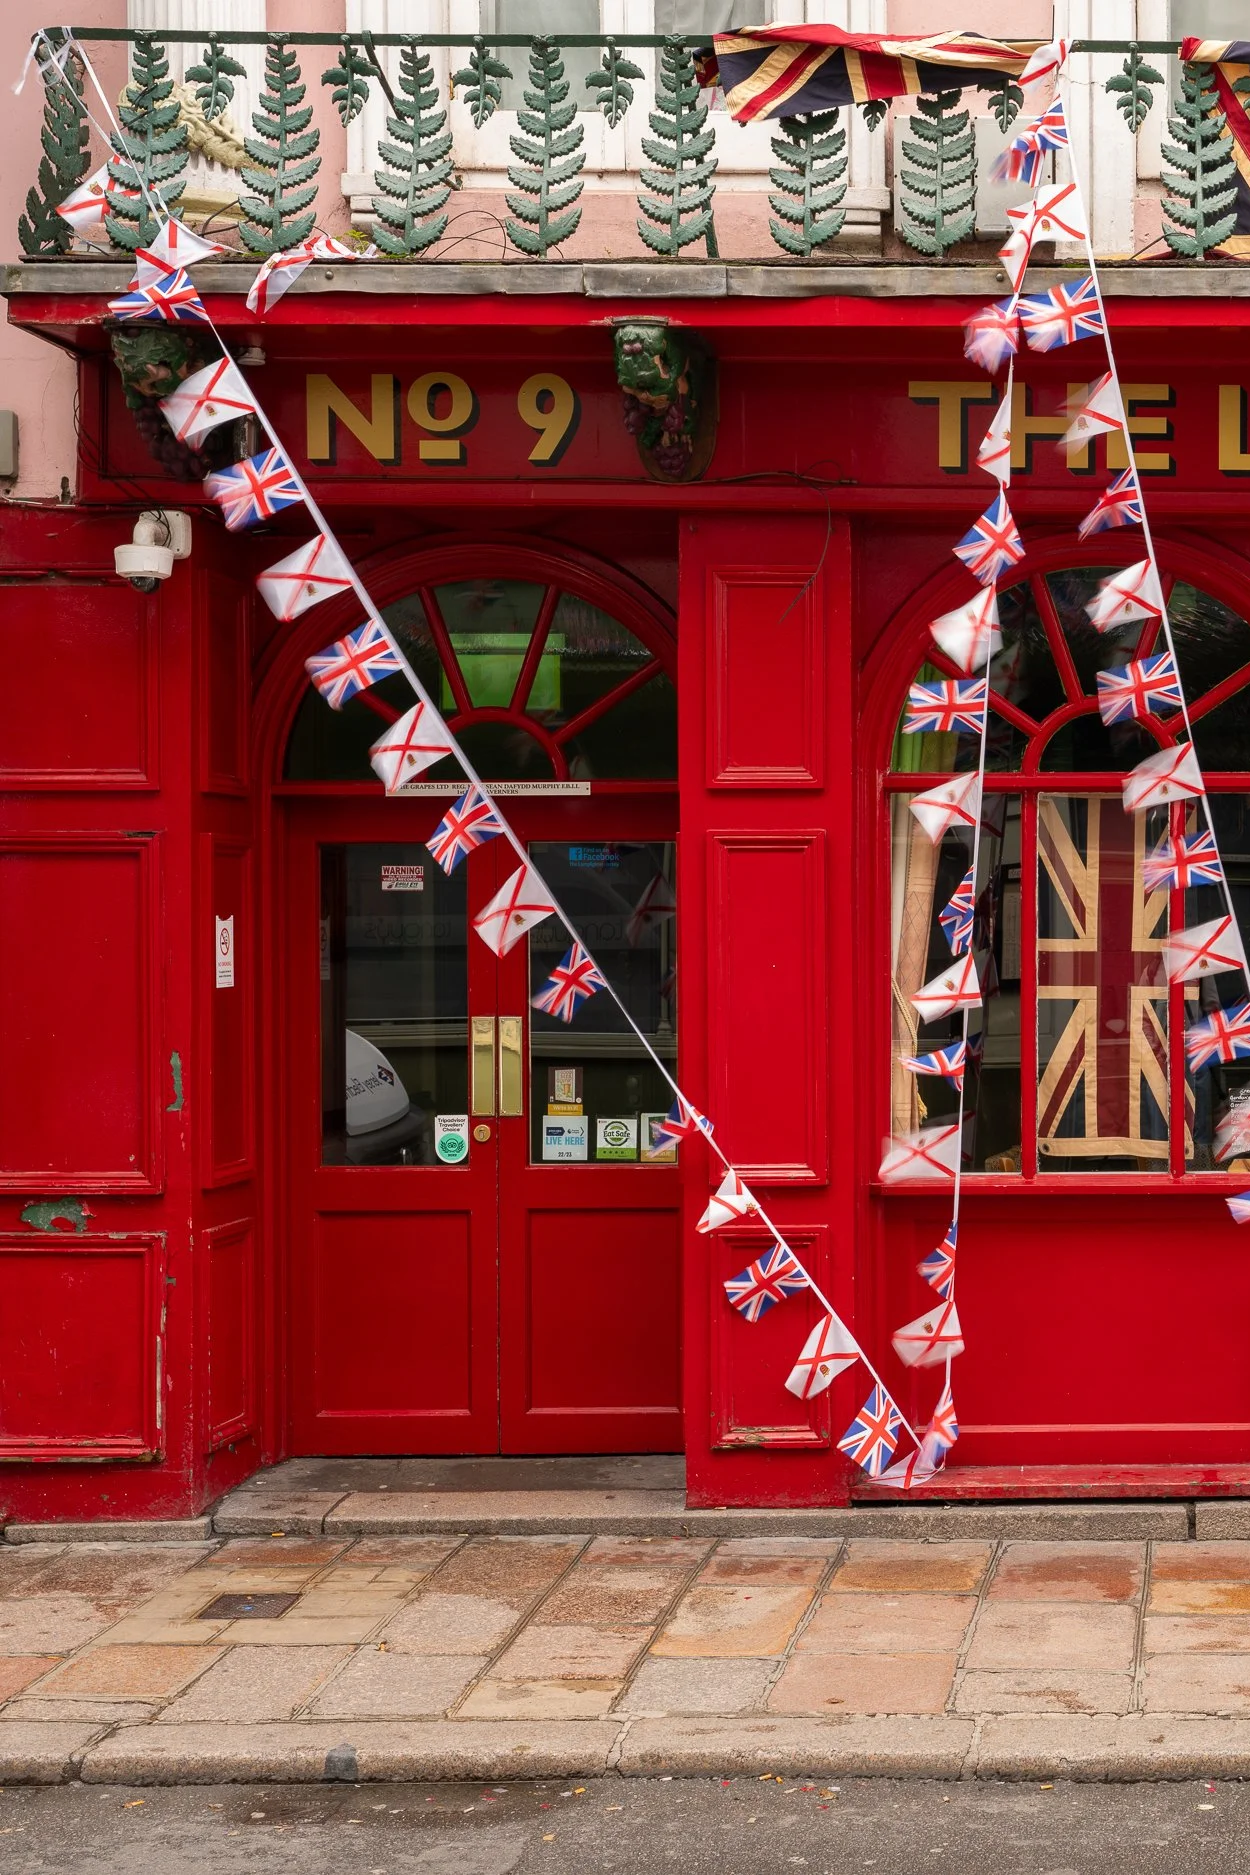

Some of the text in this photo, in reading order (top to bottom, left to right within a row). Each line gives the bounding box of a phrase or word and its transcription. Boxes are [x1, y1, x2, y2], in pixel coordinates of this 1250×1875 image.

[517, 372, 579, 464] 9
[908, 380, 1174, 474] THE
[583, 852, 620, 861] Facebook
[383, 866, 423, 875] WARNING!
[603, 1130, 631, 1138] Eat Safe
[546, 1137, 585, 1145] LIVE HERE
